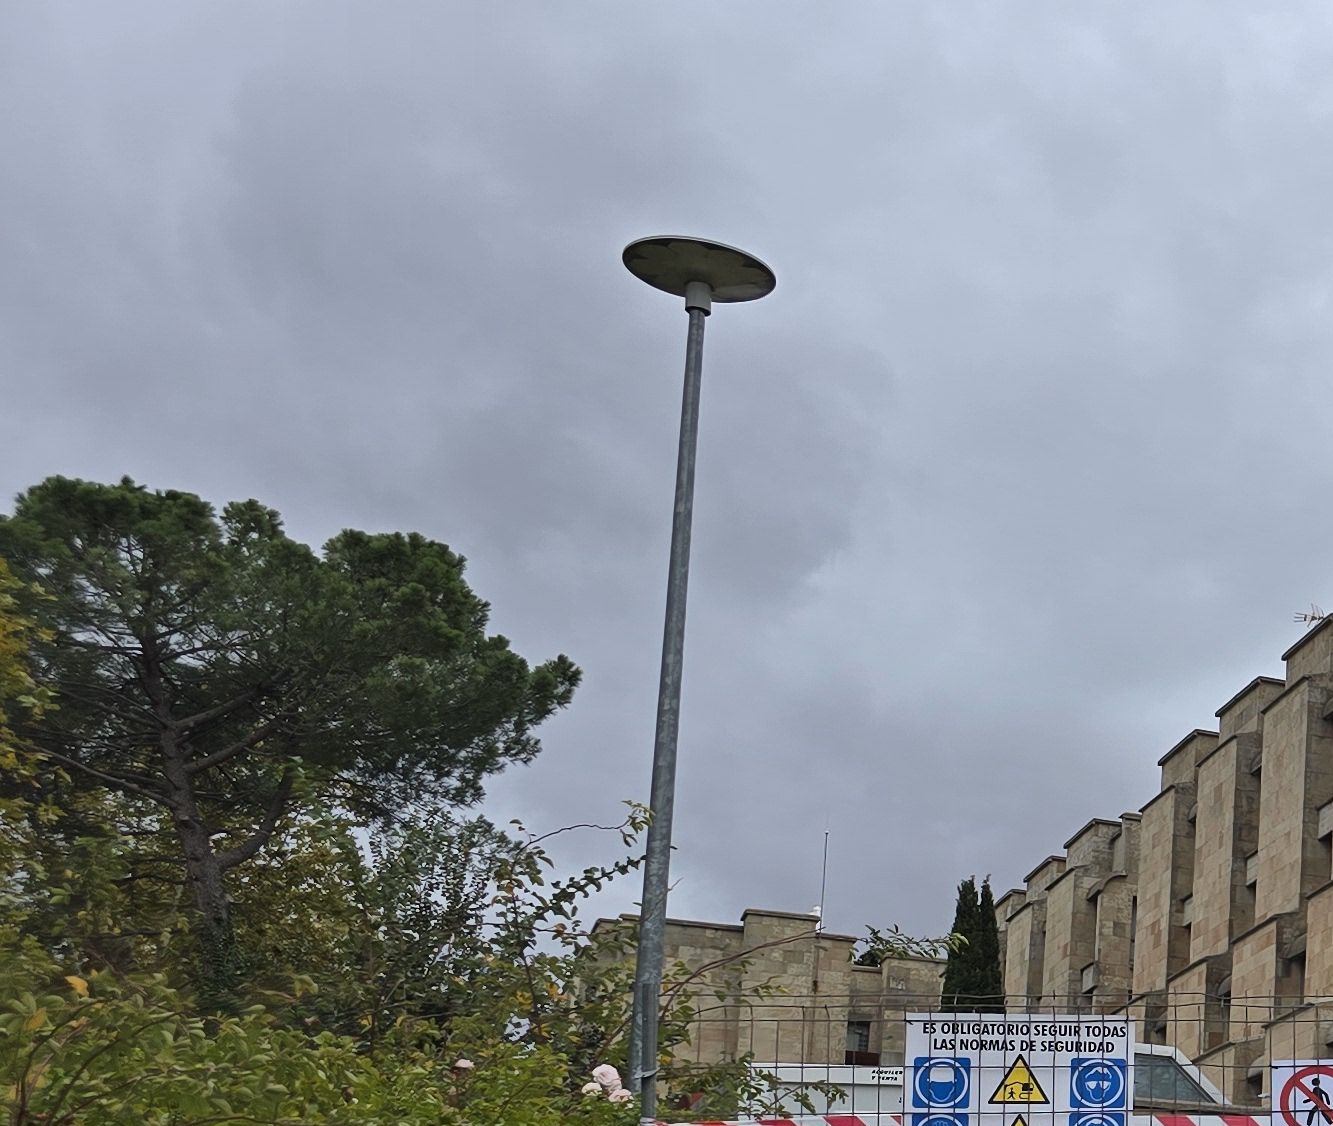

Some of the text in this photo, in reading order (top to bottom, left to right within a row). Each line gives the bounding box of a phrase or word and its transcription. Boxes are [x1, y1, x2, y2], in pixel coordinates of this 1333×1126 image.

[922, 1022, 1126, 1037] ES OBLIGATORIO SEGUIR TODAS
[933, 1038, 1115, 1053] LAS NORMAS DE SEGURIDAD
